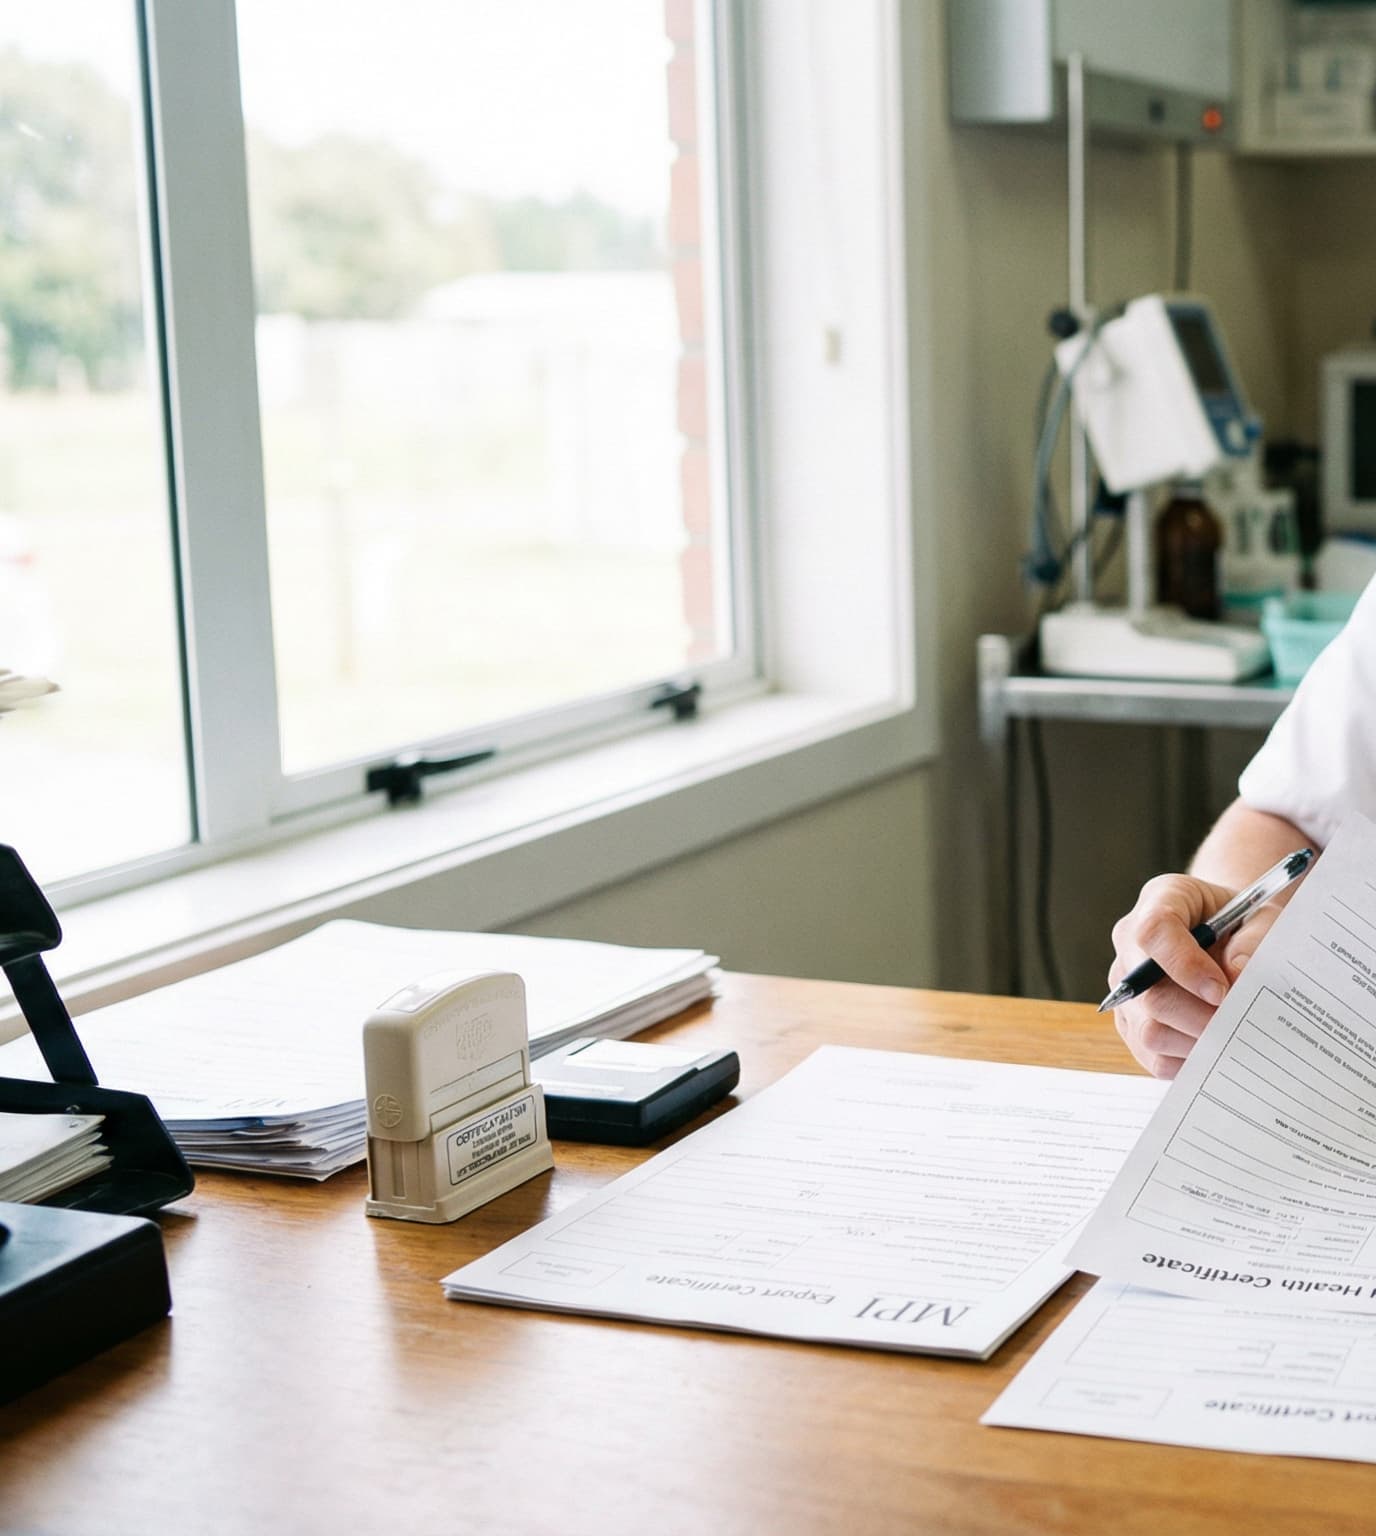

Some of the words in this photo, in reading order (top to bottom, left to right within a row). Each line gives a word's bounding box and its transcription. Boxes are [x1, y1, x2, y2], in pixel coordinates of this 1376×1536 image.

[1141, 1252, 1272, 1289] Certificate
[763, 1288, 837, 1305] Export
[1281, 1277, 1364, 1298] Health
[850, 1297, 971, 1327] MPI
